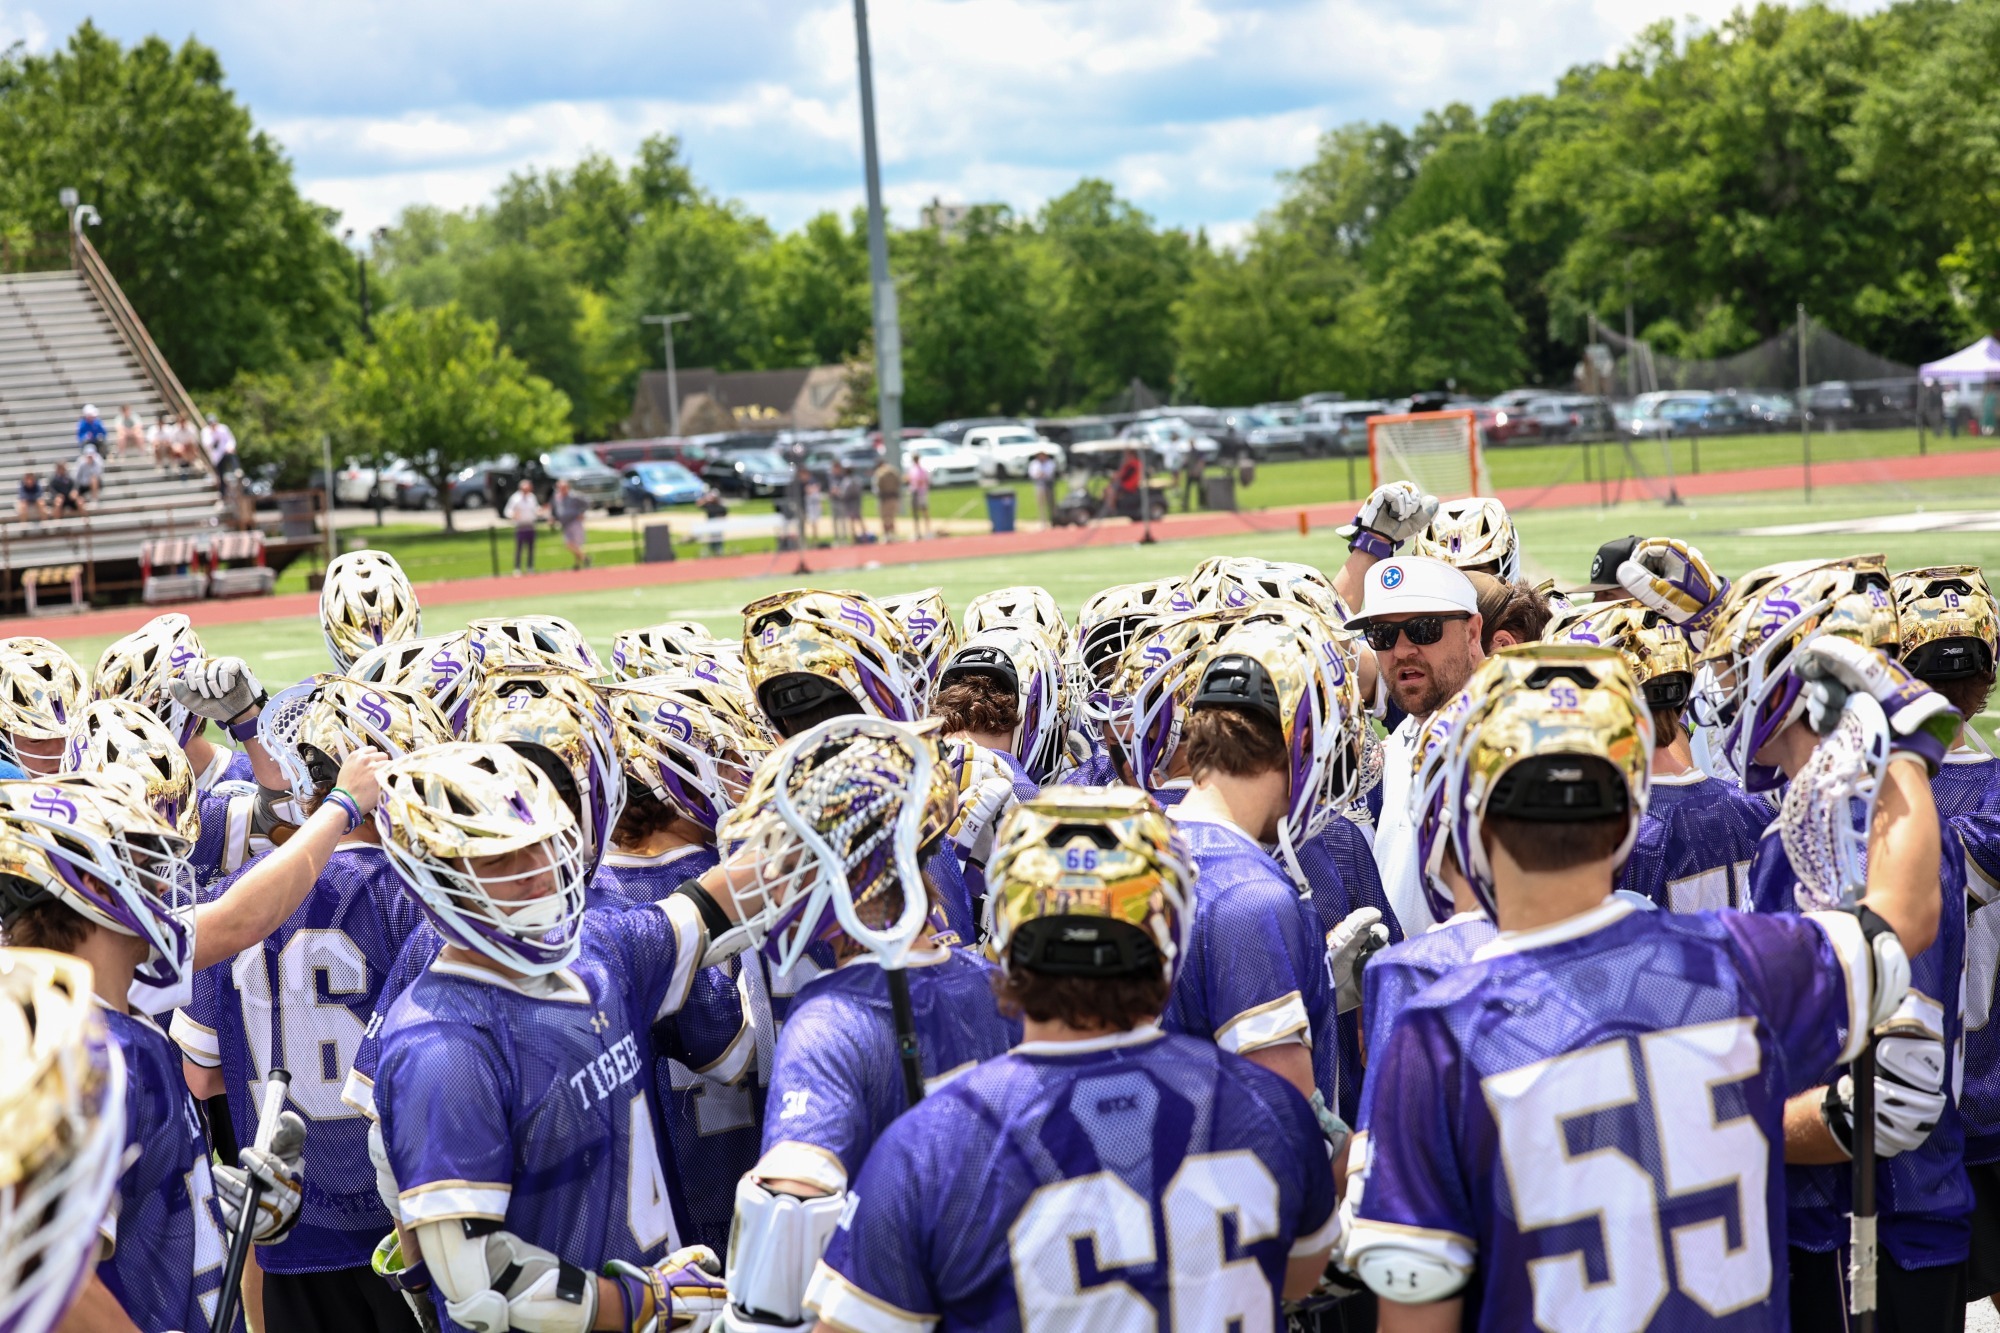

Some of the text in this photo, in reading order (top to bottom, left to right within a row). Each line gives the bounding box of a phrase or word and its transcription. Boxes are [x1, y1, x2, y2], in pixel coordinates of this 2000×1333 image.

[1868, 589, 1888, 608] 36
[1944, 594, 1959, 608] 19
[761, 628, 774, 646] 15
[1658, 624, 1675, 640] 77
[507, 695, 529, 709] 27
[1550, 688, 1577, 708] 55
[1066, 848, 1098, 870] 66
[231, 928, 367, 1121] 16
[570, 1029, 642, 1111] TIGER
[1481, 1017, 1771, 1333] 55
[1008, 1148, 1279, 1333] 66
